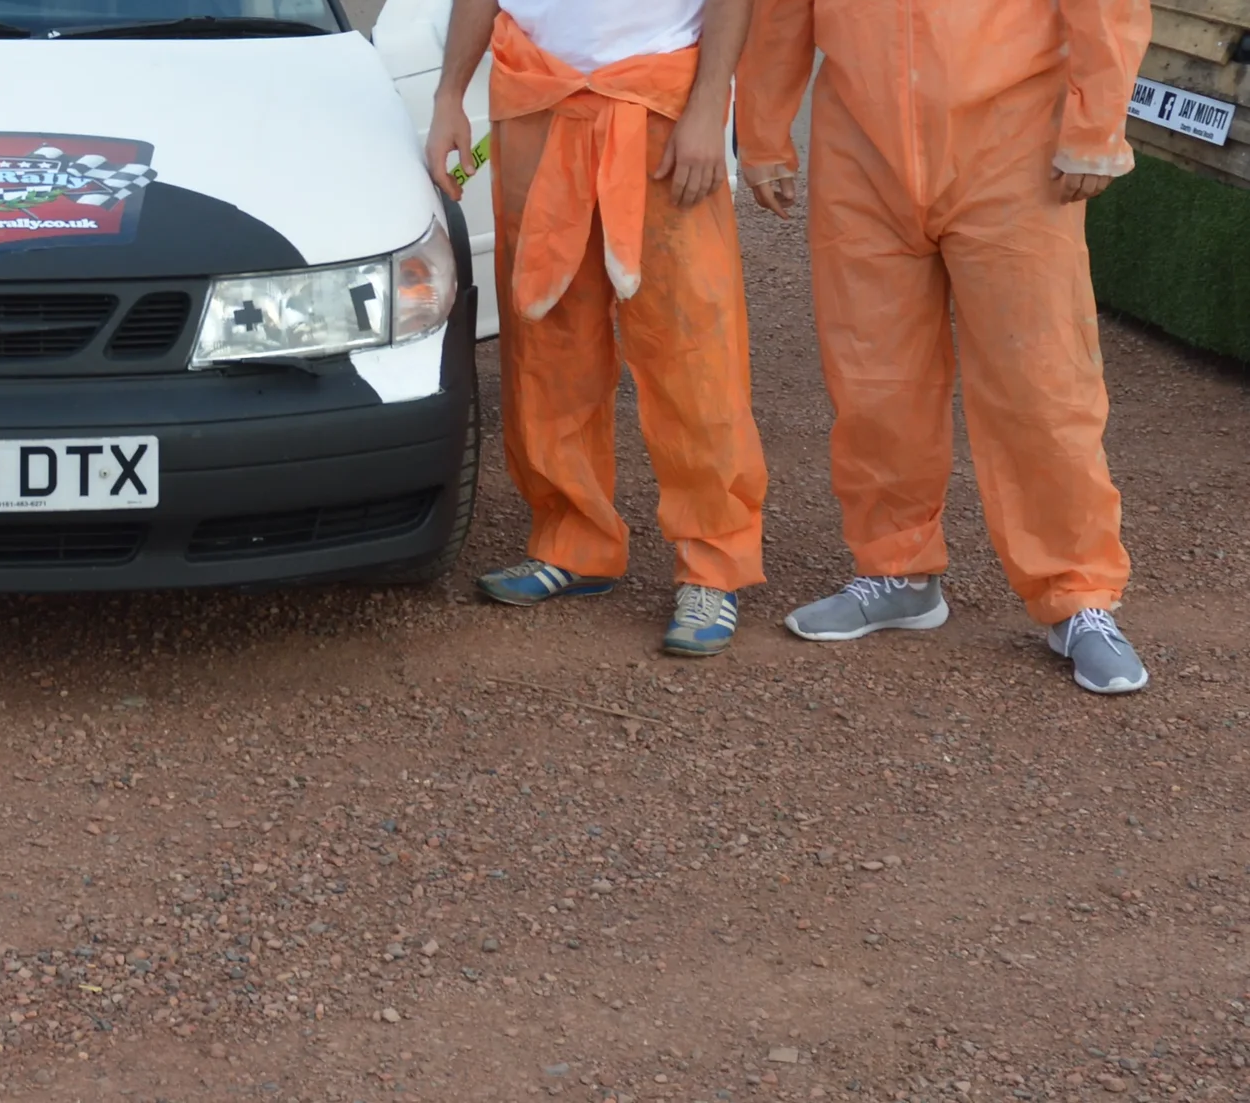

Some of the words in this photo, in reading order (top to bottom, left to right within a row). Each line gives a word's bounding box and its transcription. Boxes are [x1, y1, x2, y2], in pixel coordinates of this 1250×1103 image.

[1131, 83, 1155, 107] HAM
[1178, 98, 1197, 120] JAY
[19, 443, 148, 498] DTX
